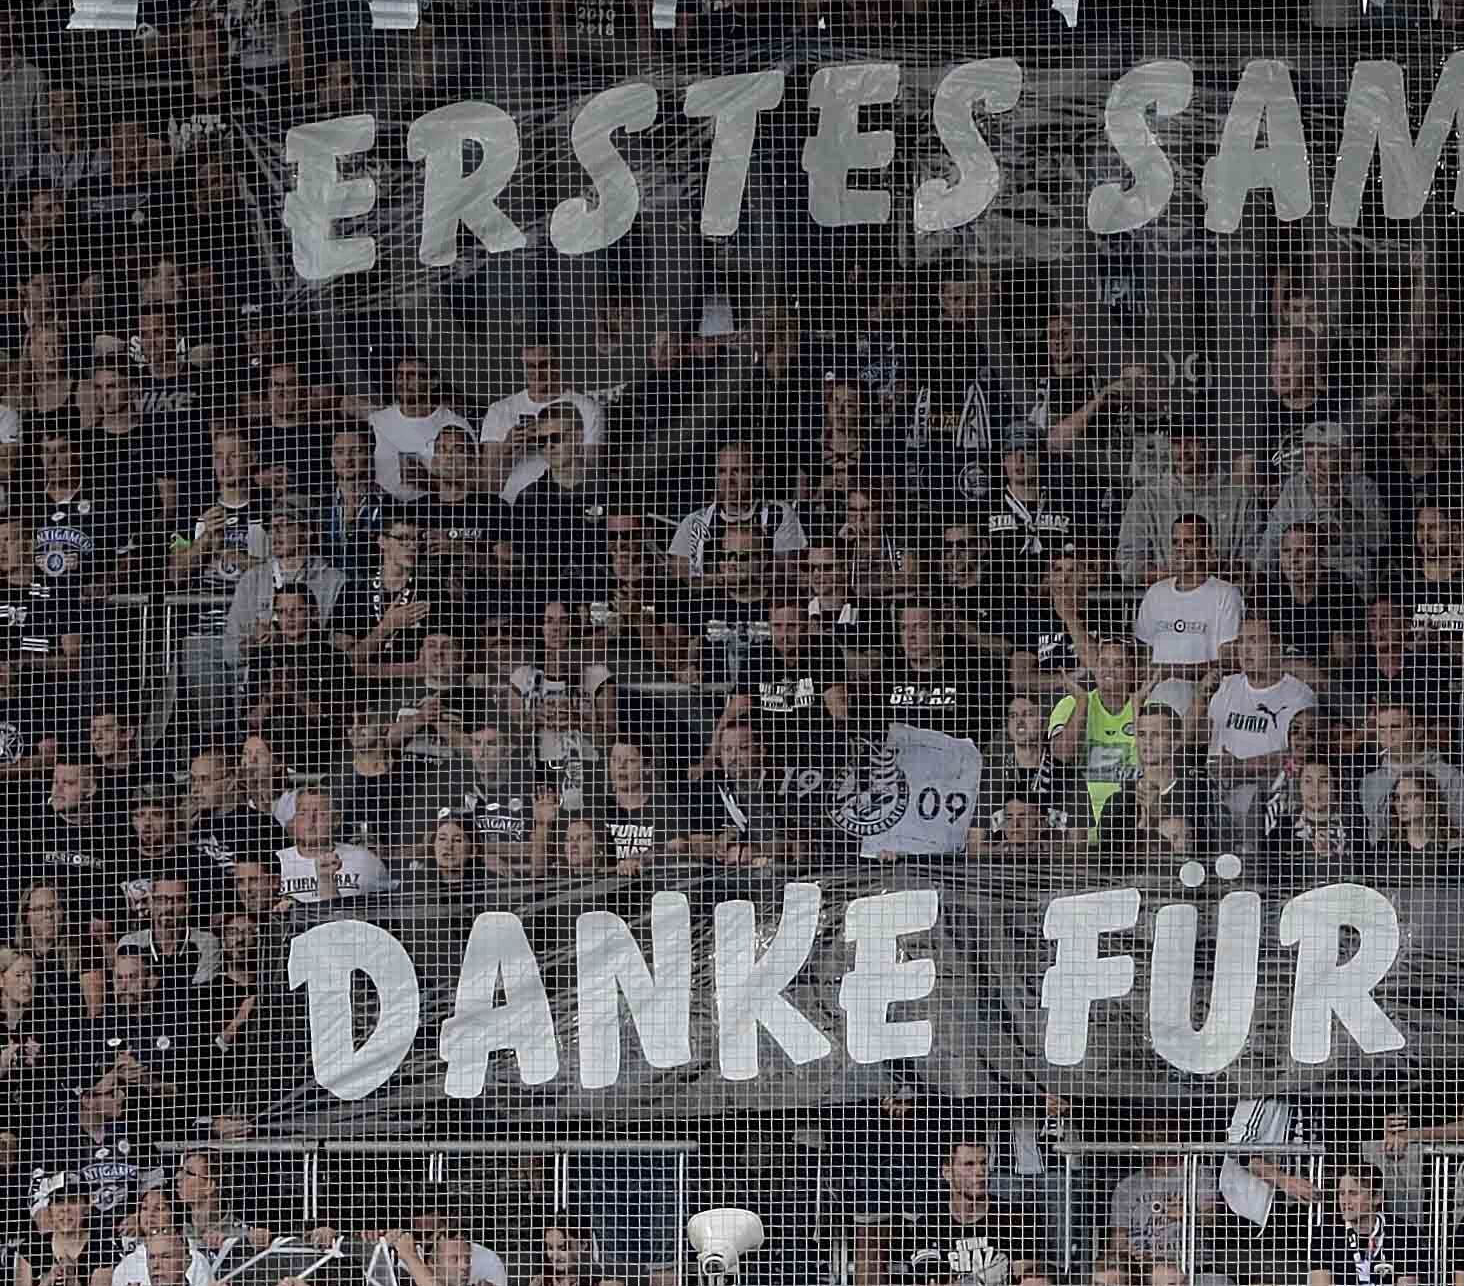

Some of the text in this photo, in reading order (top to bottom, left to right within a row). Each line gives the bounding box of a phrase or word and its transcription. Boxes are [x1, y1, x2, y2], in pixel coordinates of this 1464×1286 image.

[283, 57, 1021, 281] ERSTES
[1225, 712, 1269, 734] PUMA
[916, 785, 968, 822] 09
[287, 881, 940, 1101] DANKE
[1041, 853, 1405, 1075] FÜR
